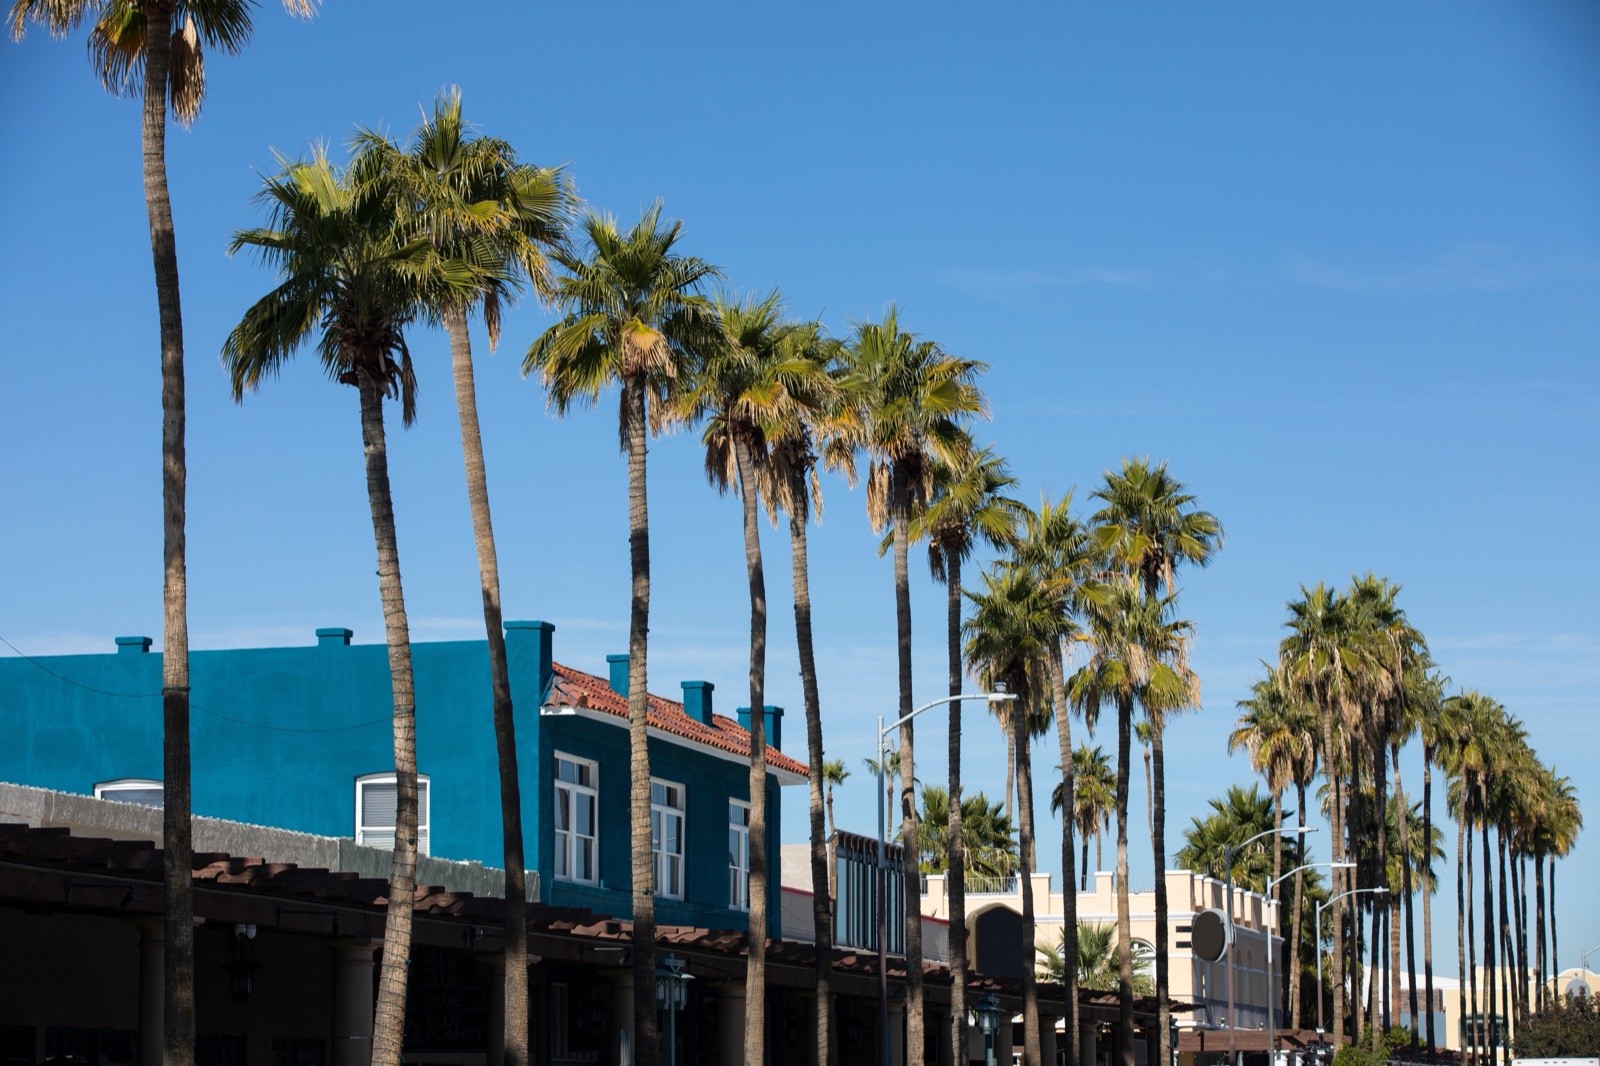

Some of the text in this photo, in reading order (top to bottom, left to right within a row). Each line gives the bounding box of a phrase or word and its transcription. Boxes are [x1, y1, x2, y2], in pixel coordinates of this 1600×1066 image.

[424, 975, 460, 987] BLUE
[425, 994, 462, 1007] BLUE
[426, 1014, 463, 1027] BLUE
[426, 1027, 484, 1040] PLANET
